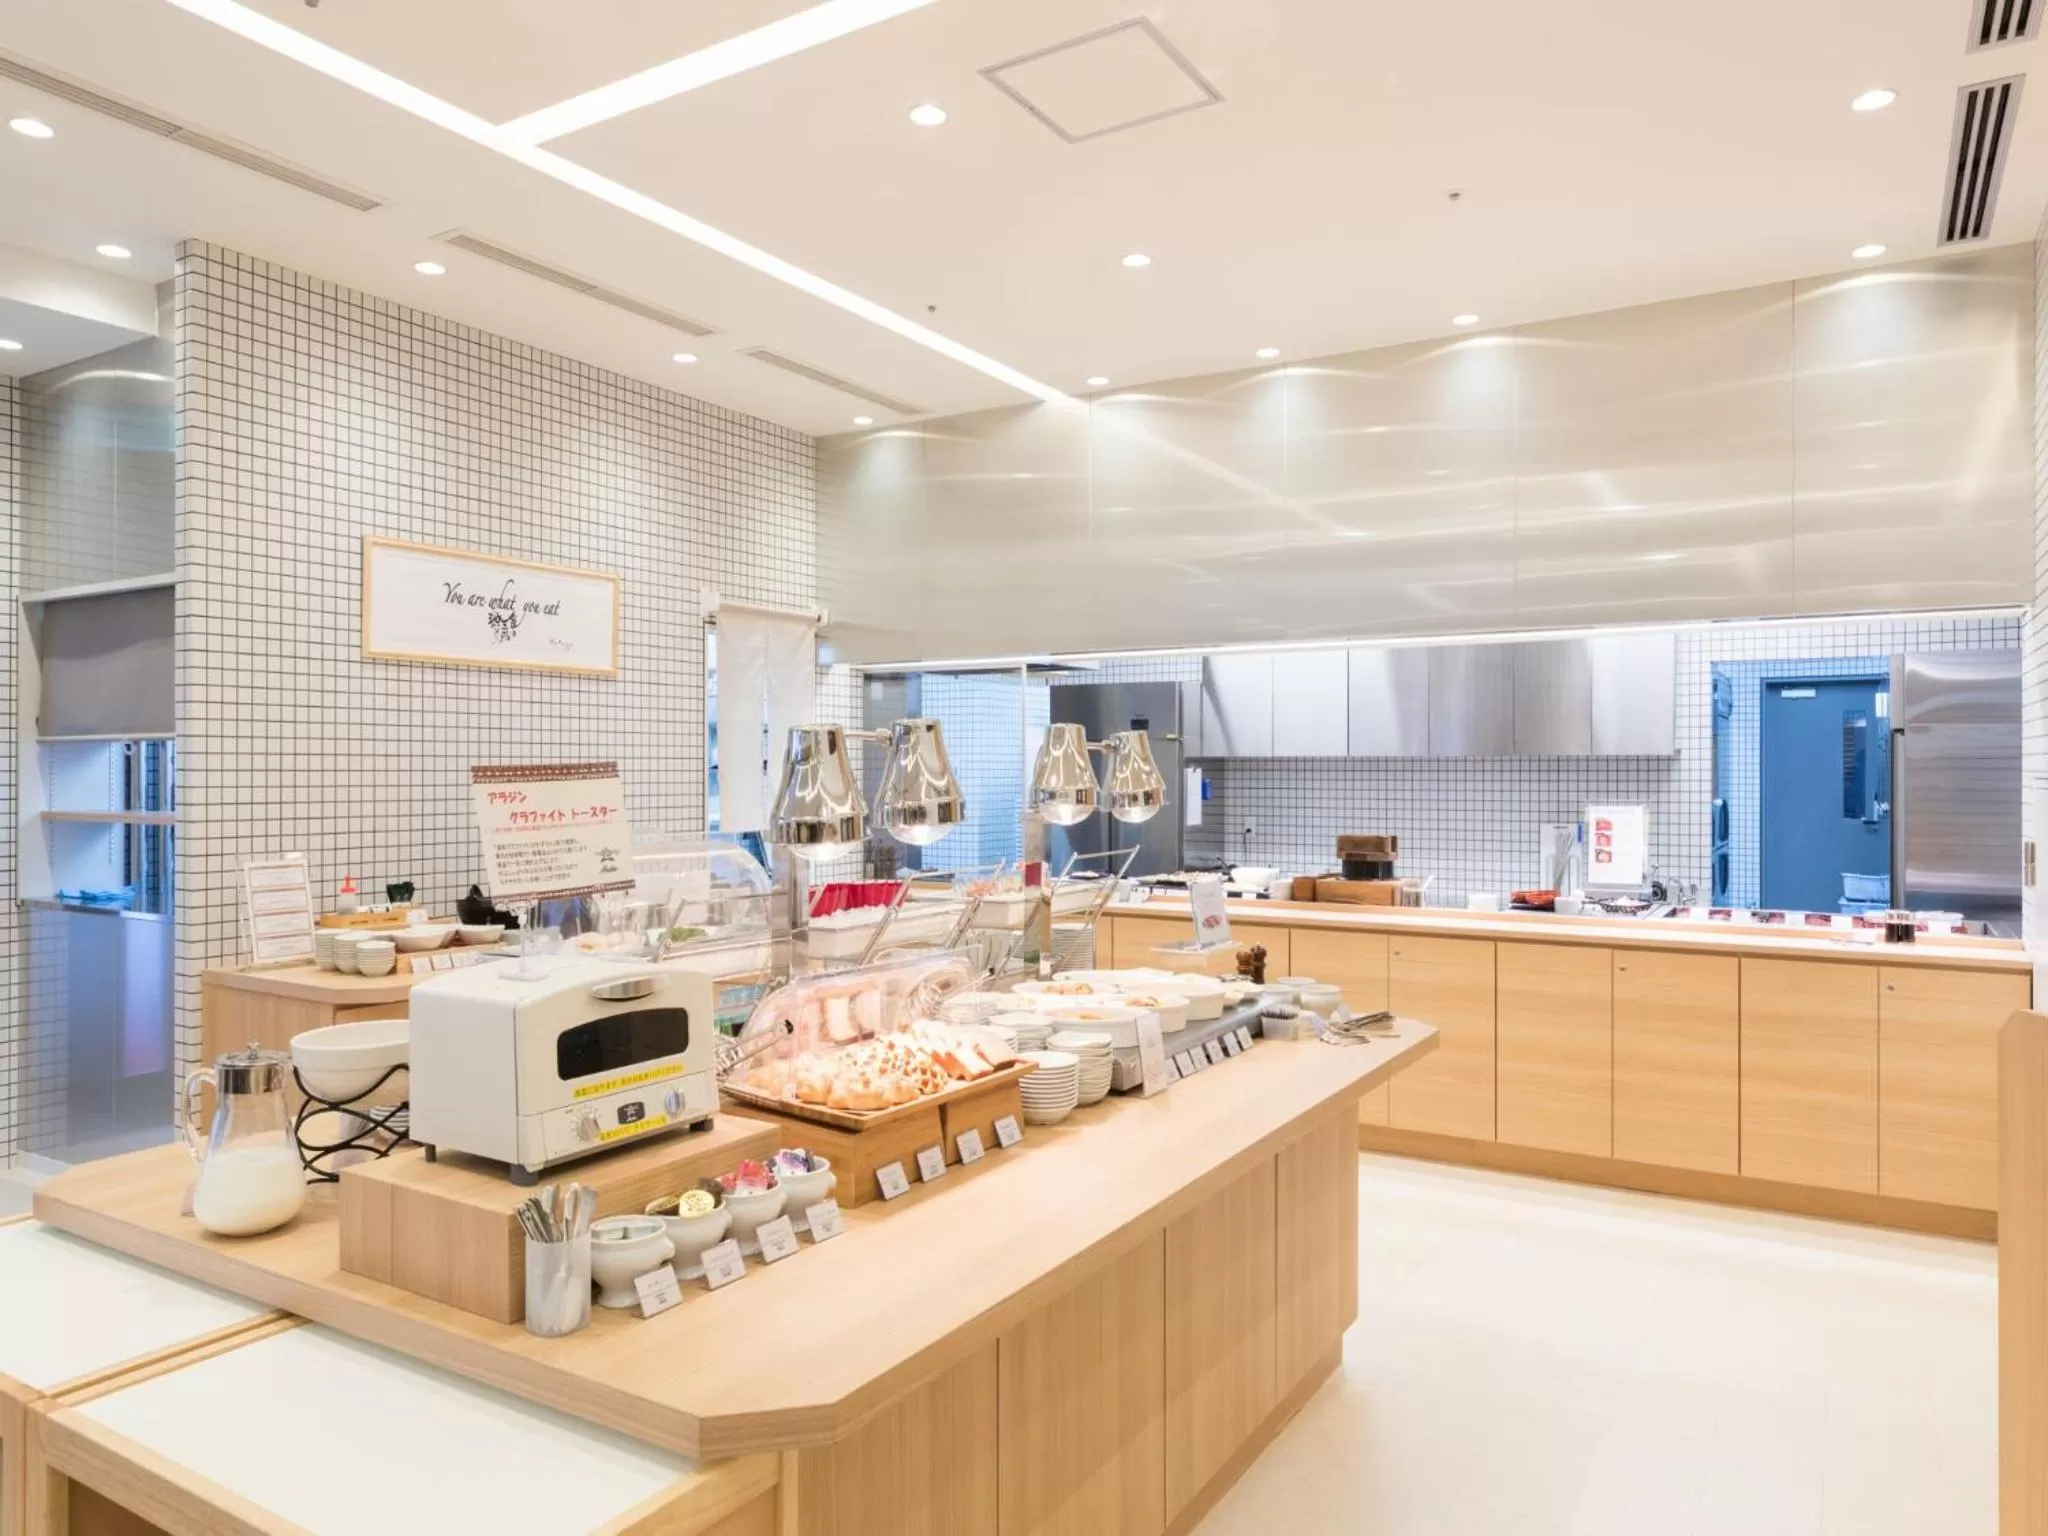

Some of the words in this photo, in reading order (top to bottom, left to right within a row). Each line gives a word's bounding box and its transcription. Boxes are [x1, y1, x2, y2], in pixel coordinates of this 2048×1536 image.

[443, 582, 465, 605] You
[467, 593, 486, 608] are
[487, 578, 518, 610] what
[516, 600, 541, 629] you
[543, 600, 561, 616] eat
[487, 790, 528, 805] アラジン
[571, 805, 618, 821] トースター
